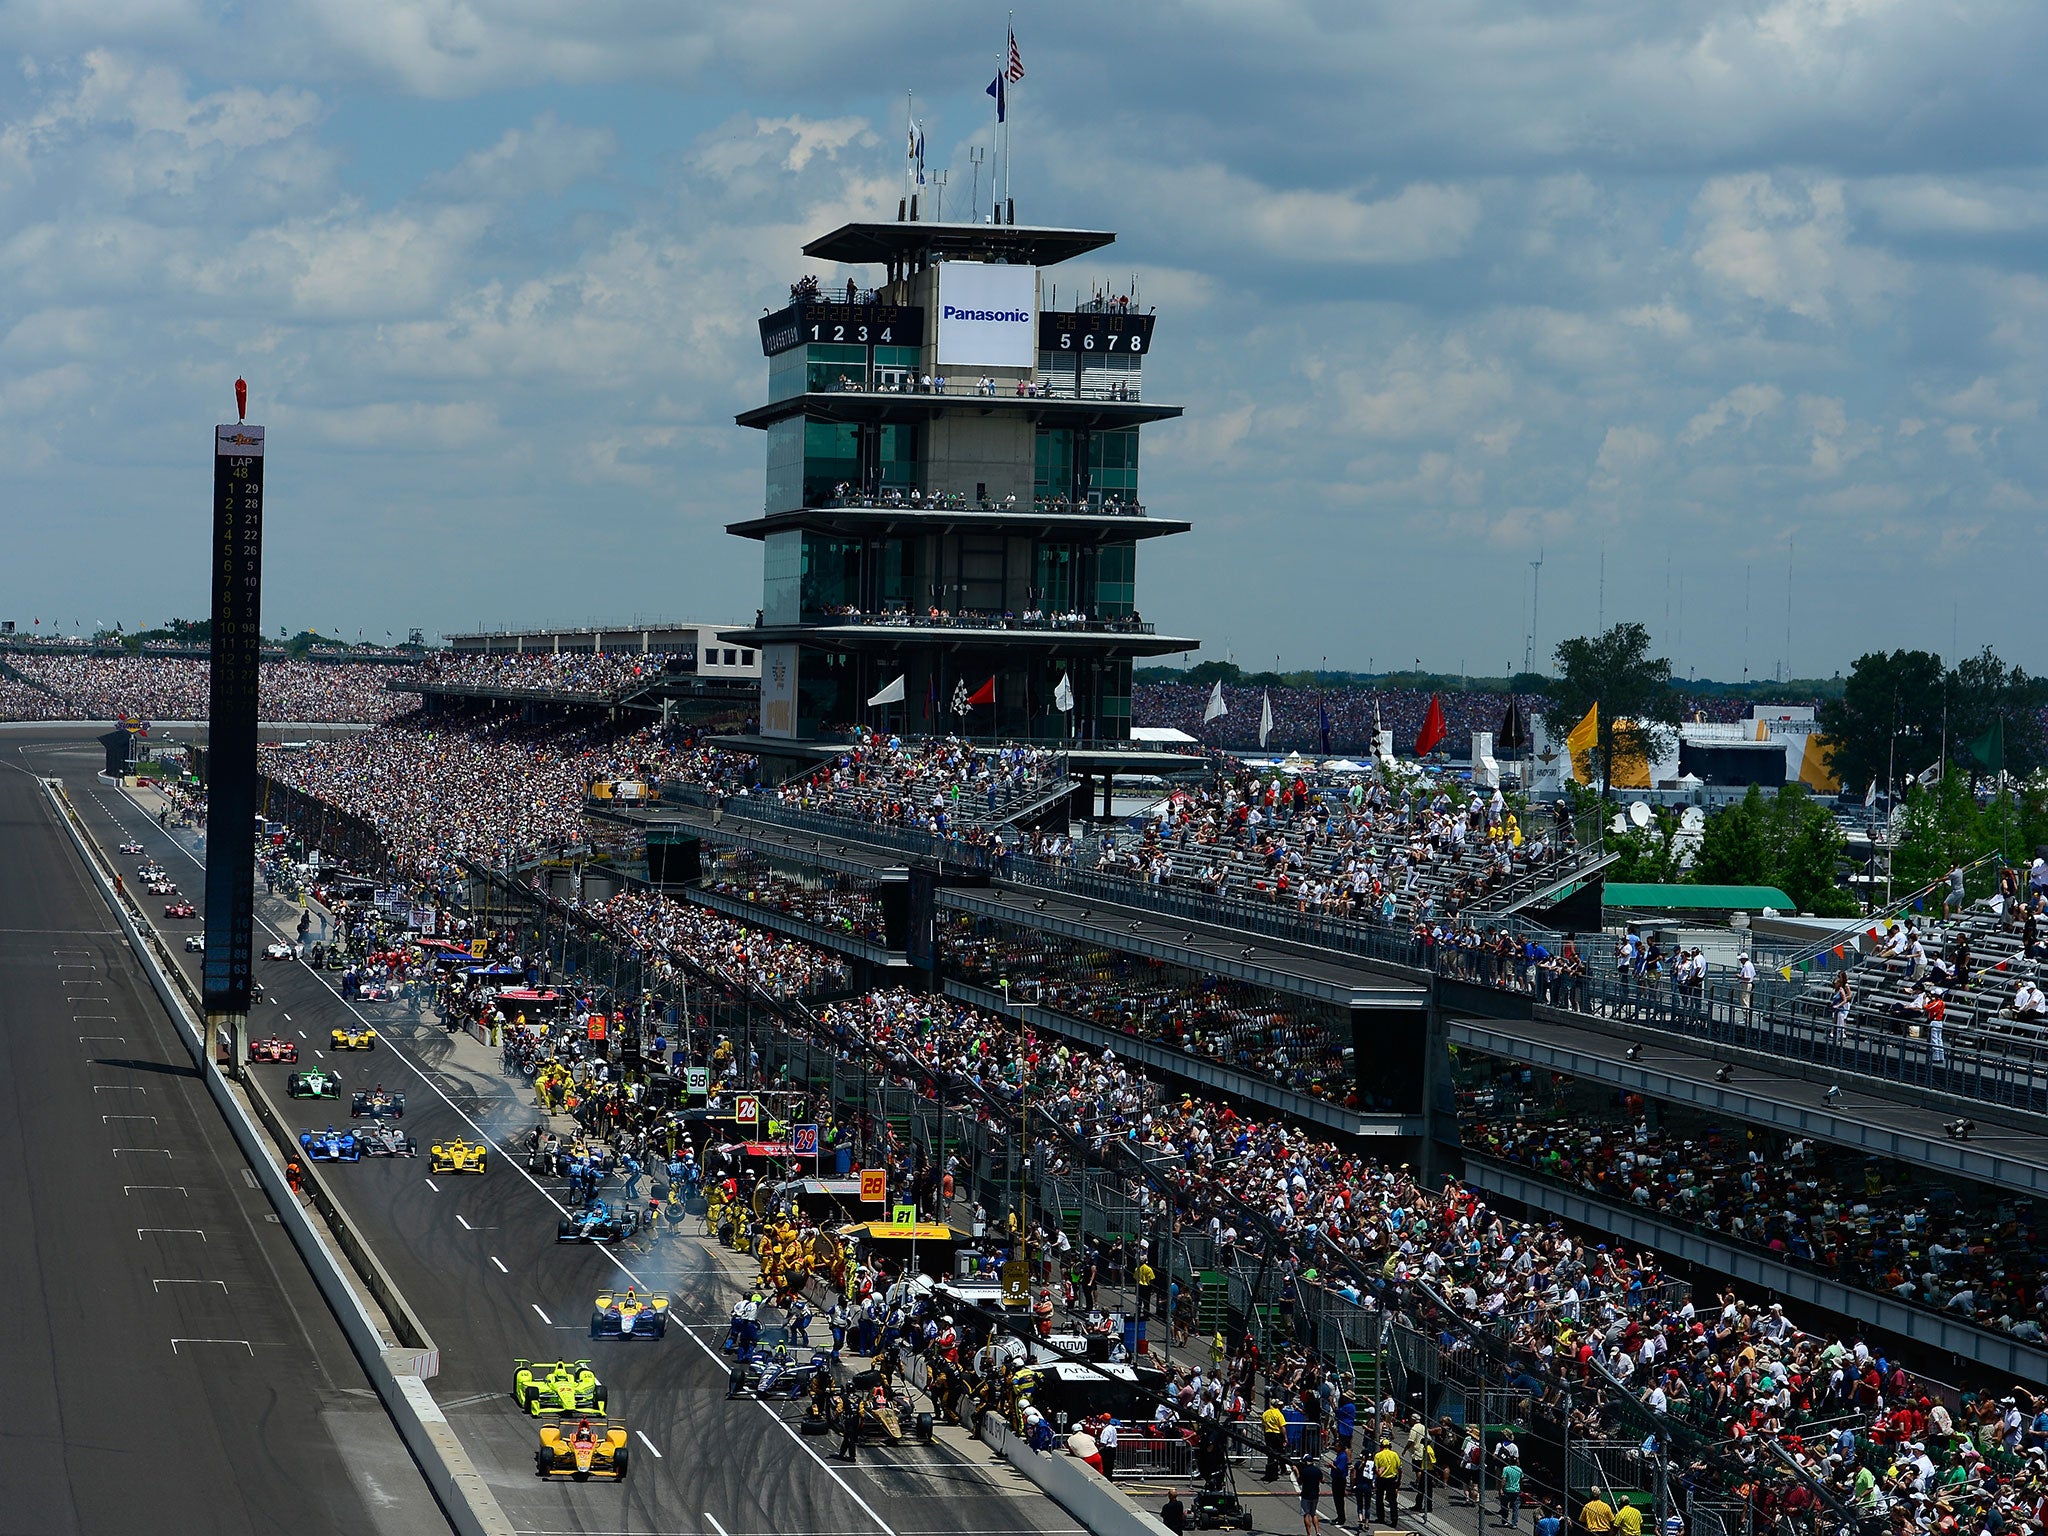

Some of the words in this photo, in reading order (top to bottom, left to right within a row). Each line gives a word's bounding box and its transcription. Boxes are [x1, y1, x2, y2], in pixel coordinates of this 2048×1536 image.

[943, 306, 1029, 323] Panasonic
[811, 324, 819, 341] 1
[833, 325, 845, 342] 2
[857, 326, 869, 342] 3
[880, 327, 892, 343] 4
[1060, 333, 1071, 349] 5
[1083, 334, 1095, 350] 6
[1107, 335, 1119, 351] 7
[1130, 335, 1141, 352] 8
[230, 457, 253, 467] LAP
[233, 467, 249, 478] 48
[228, 482, 234, 494] 1
[245, 484, 259, 494] 29
[225, 498, 234, 509] 2
[245, 499, 258, 509] 28
[225, 513, 233, 525] 3
[245, 514, 258, 524] 21
[224, 529, 233, 540] 4
[244, 530, 257, 540] 22
[224, 544, 233, 556] 5
[243, 545, 257, 555] 26
[223, 560, 232, 572] 6
[247, 561, 254, 571] 5
[223, 575, 232, 587] 7
[243, 576, 257, 587] 10
[223, 590, 231, 603] 8
[246, 592, 253, 602] 7
[222, 606, 231, 618] 9
[246, 607, 252, 617] 3
[220, 622, 236, 634] 10
[242, 623, 256, 633] 98
[221, 638, 235, 649] 11
[243, 639, 256, 649] 12
[220, 653, 235, 664] 12
[474, 945, 485, 953] 27
[233, 963, 248, 975] 63
[235, 979, 243, 991] 4
[690, 1074, 706, 1087] 98
[738, 1101, 756, 1118] 26
[795, 1129, 816, 1150] 29
[863, 1177, 883, 1194] 28
[896, 1210, 911, 1223] 21
[1011, 1281, 1020, 1292] 5
